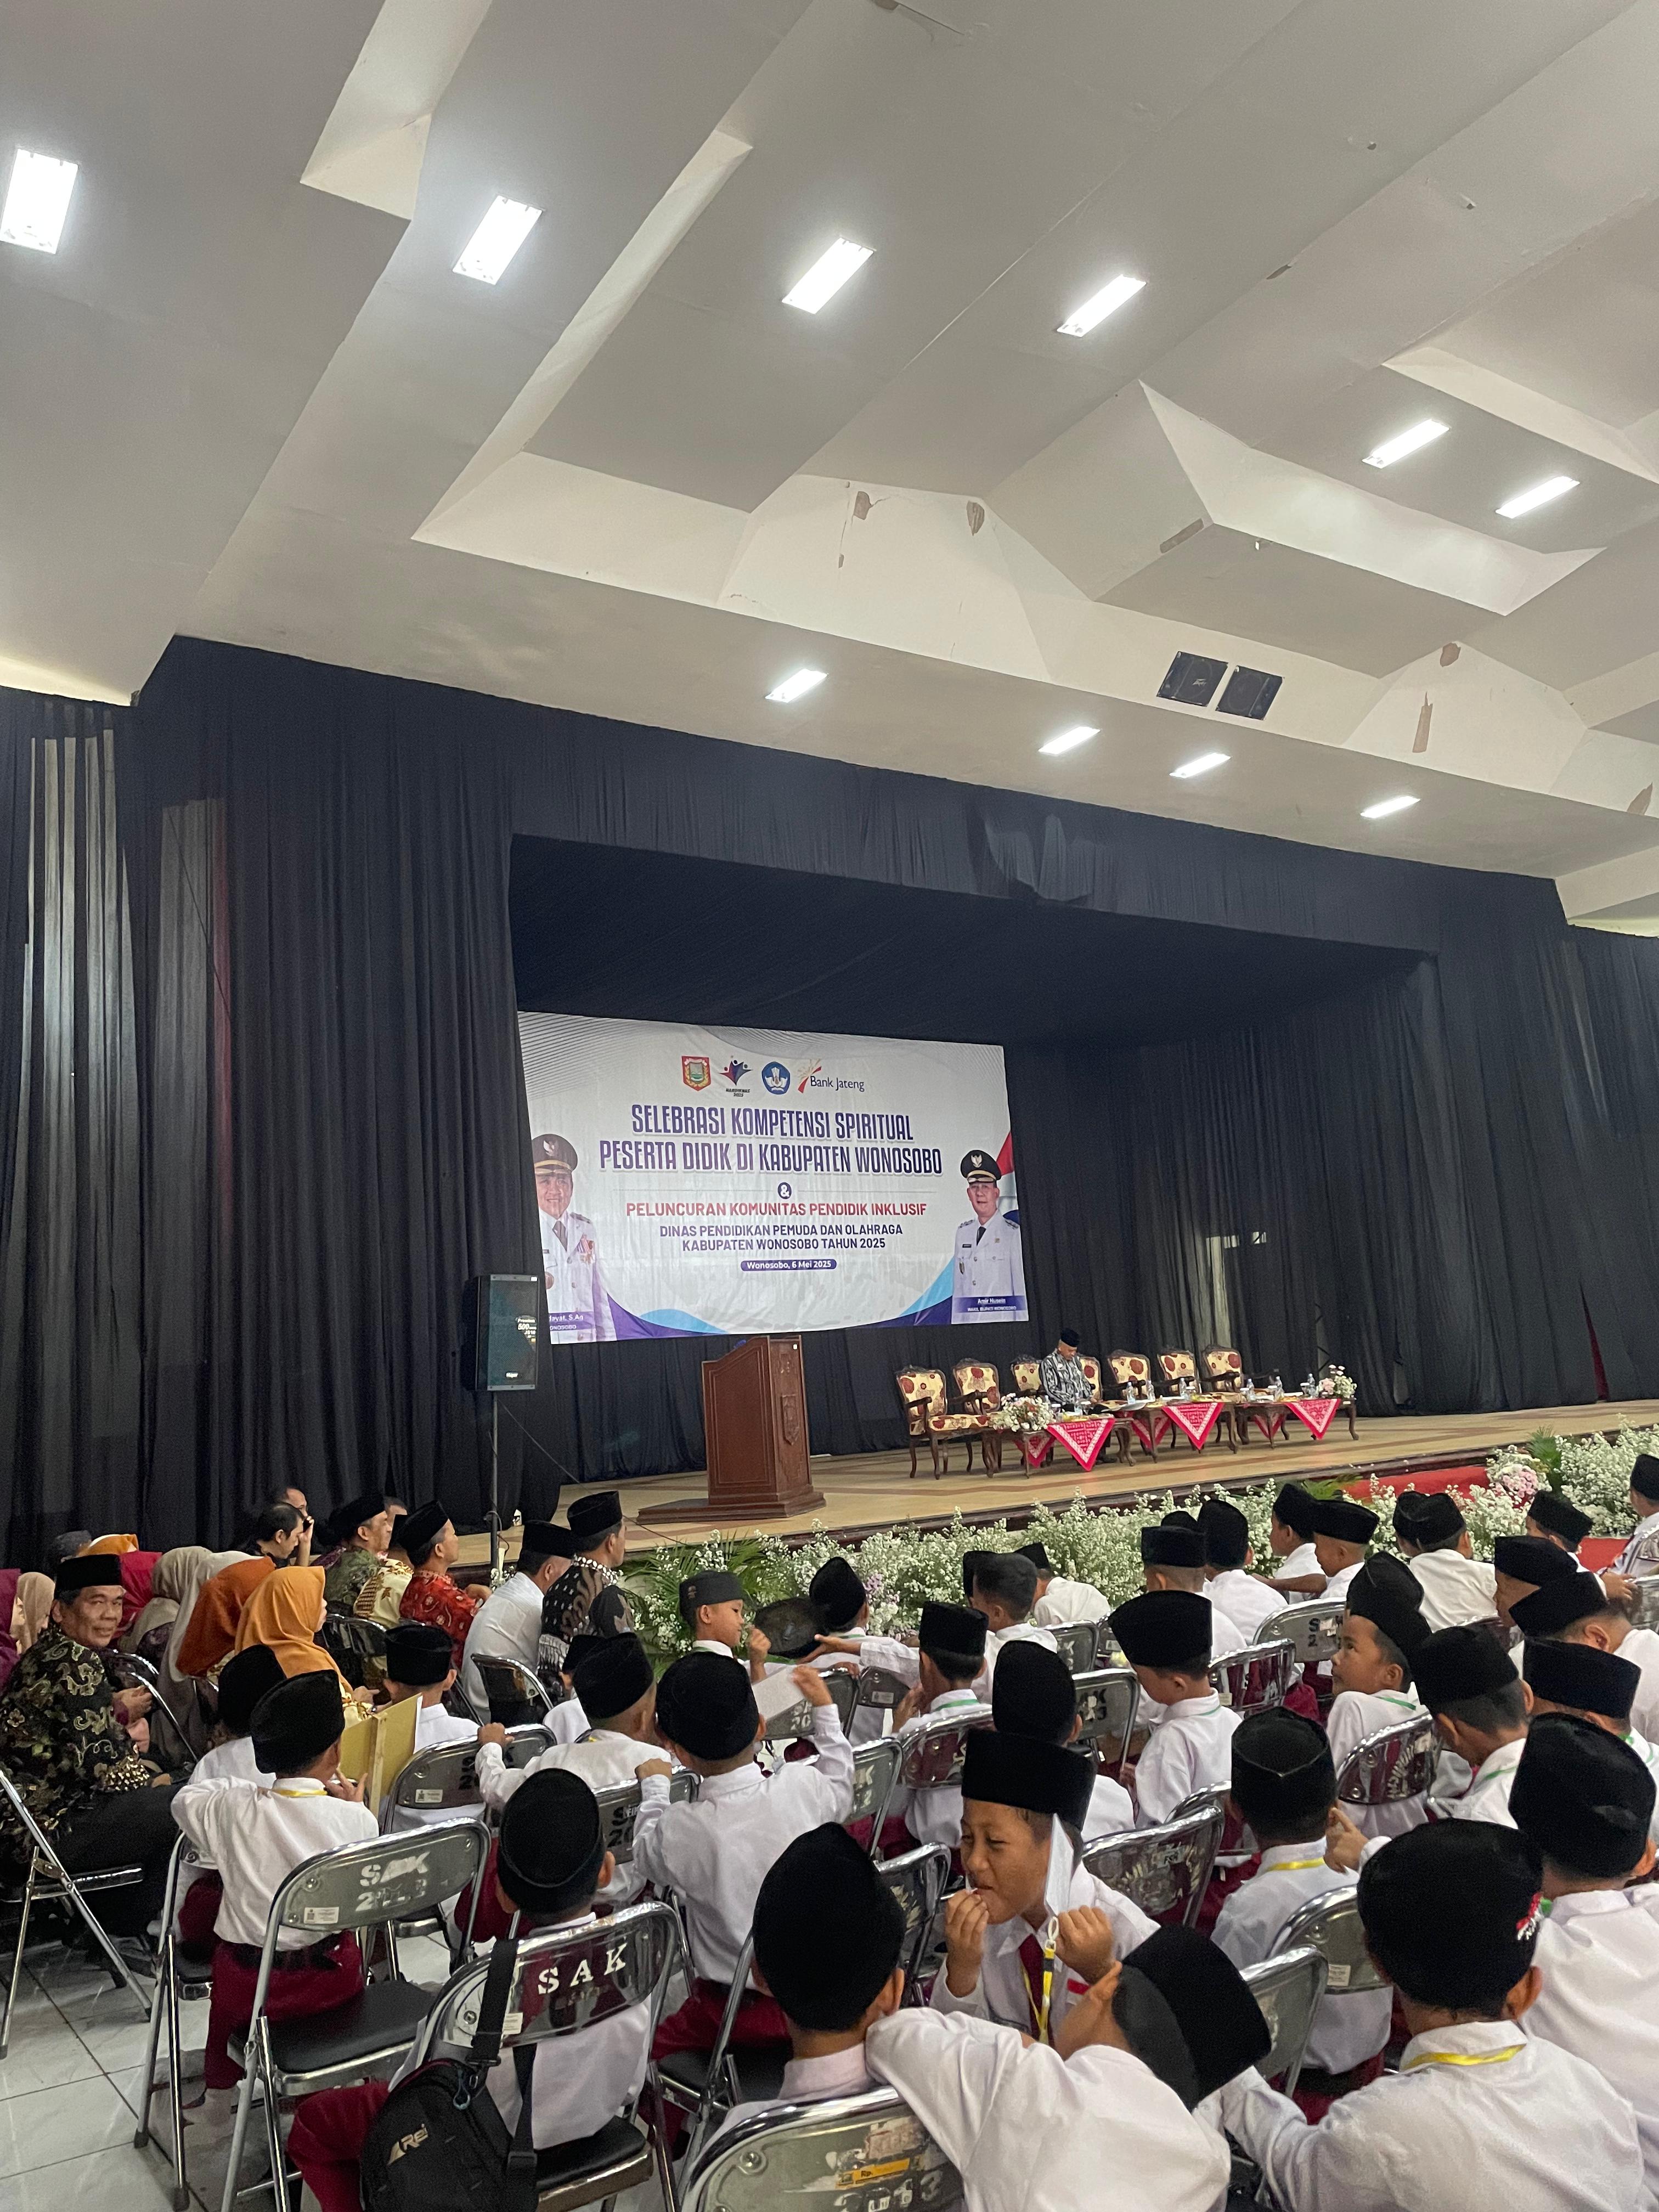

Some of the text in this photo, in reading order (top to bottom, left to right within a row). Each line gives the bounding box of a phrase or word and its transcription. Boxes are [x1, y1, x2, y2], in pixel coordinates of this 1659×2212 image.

[810, 1076, 865, 1092] Bank Jateng
[632, 1104, 913, 1140] SELEBRASI KOMPETENSI SPIRITUAL
[600, 1140, 942, 1174] PESERTA DIDIK DI KABUPATEN WONOSOBO
[780, 1184, 790, 1198] &
[626, 1203, 927, 1216] PELUNCURAN KOMUNITAS PENDIDIK INKLUSIF
[660, 1224, 903, 1237] DINAS PENDIDIKAN PEMUDA DAN OLAHRAGA
[682, 1238, 885, 1251] KABUPATEN WONOSOBO TAHUN 2025
[747, 1261, 791, 1269] Wonosobo,
